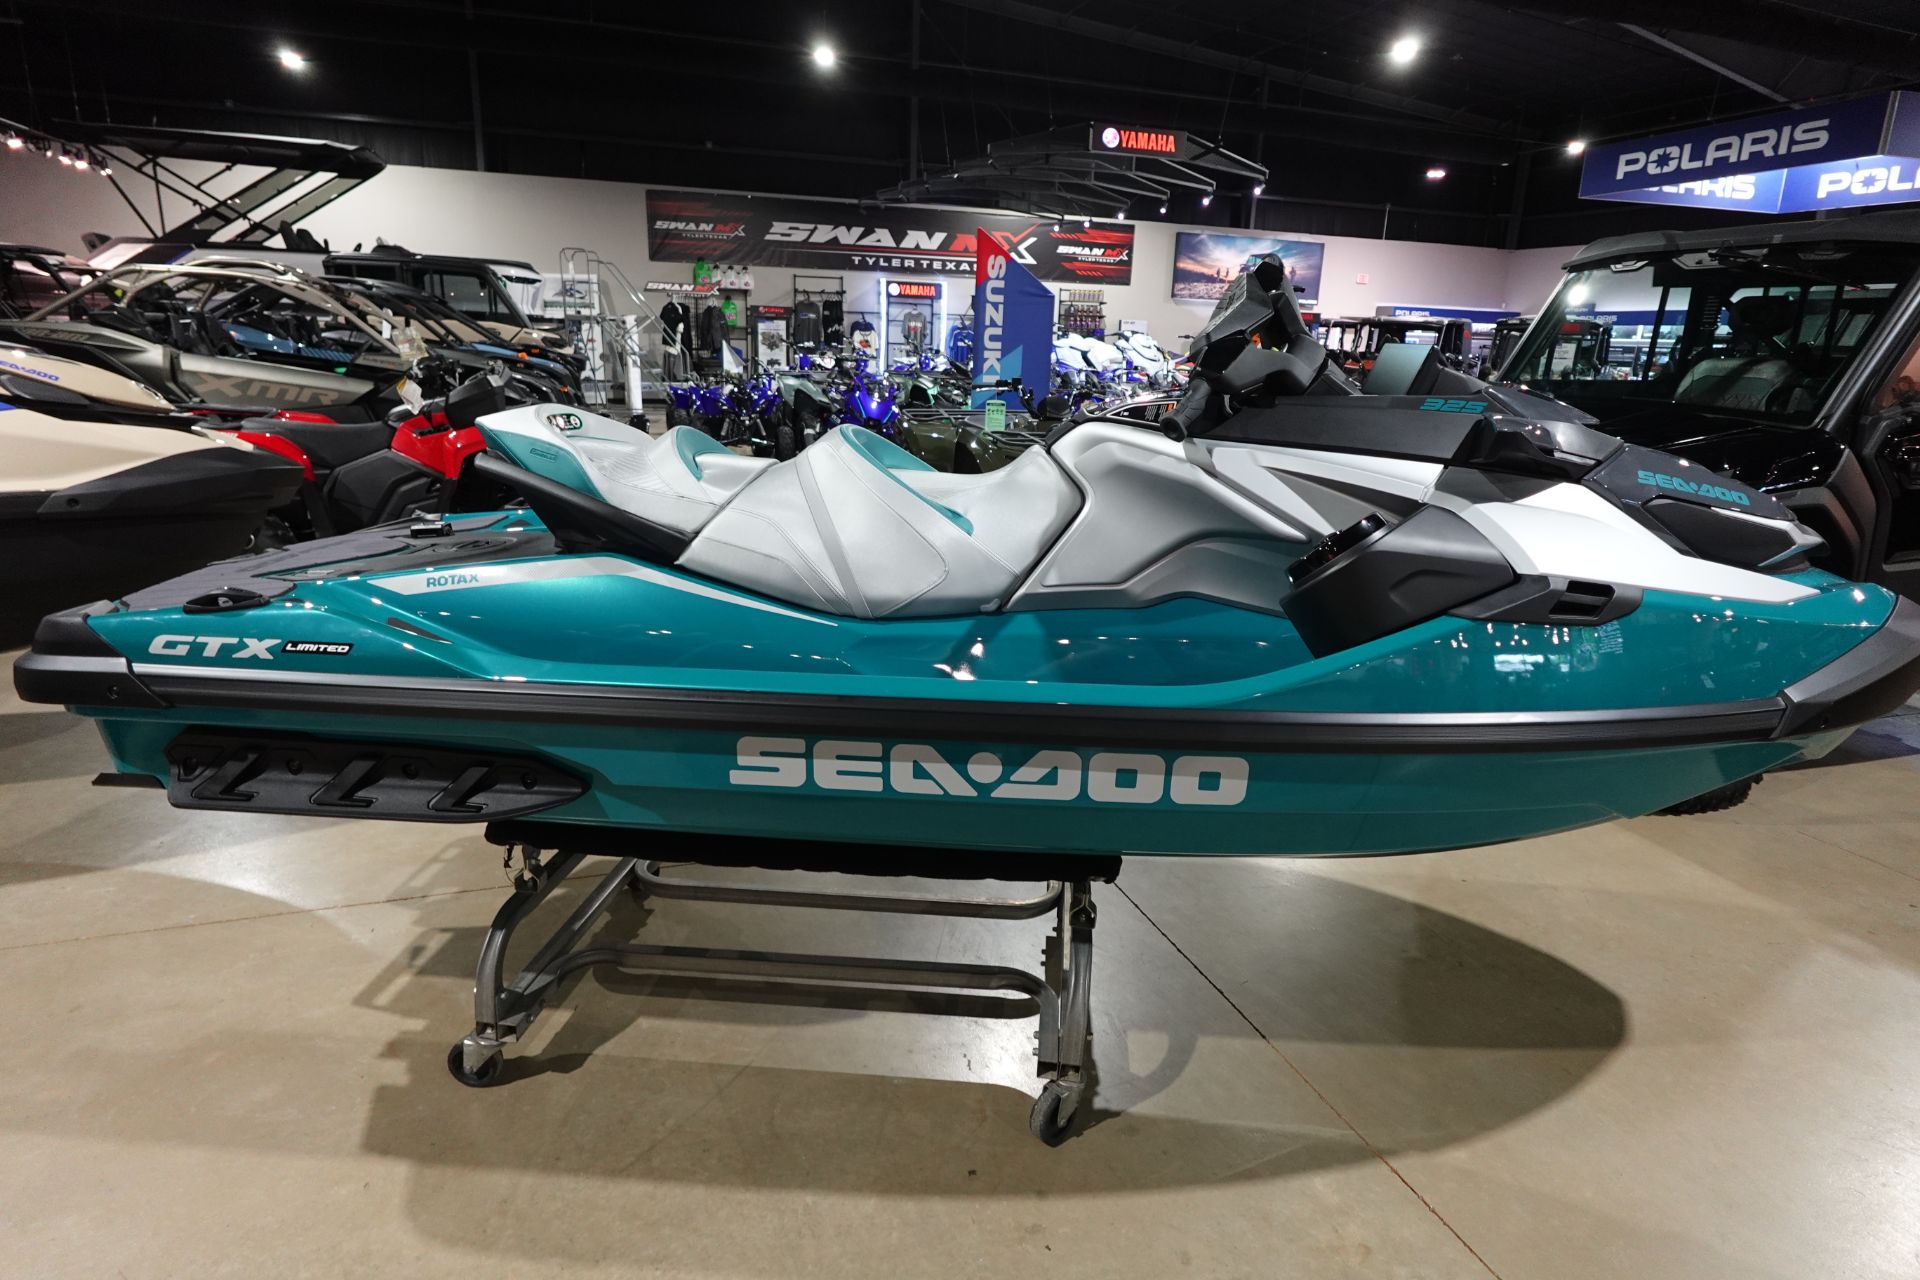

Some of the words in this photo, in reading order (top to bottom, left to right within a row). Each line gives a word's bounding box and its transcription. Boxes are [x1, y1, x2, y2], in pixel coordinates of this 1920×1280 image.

[1120, 130, 1176, 152] YAMAHA
[1616, 118, 1830, 180] POLARIS
[1816, 165, 1920, 199] POL
[654, 220, 714, 231] SWAN
[764, 221, 948, 251] SWAN
[1056, 245, 1105, 256] SWAN
[852, 256, 915, 269] TYLER
[646, 282, 695, 292] SWAN
[900, 284, 936, 297] YAMAHA
[982, 254, 1007, 383] SUZUKI
[1395, 309, 1430, 317] POLARIS
[1420, 398, 1489, 414] 325
[426, 573, 480, 589] ROTAX
[148, 634, 282, 660] GTX
[285, 642, 350, 653] LIMITED
